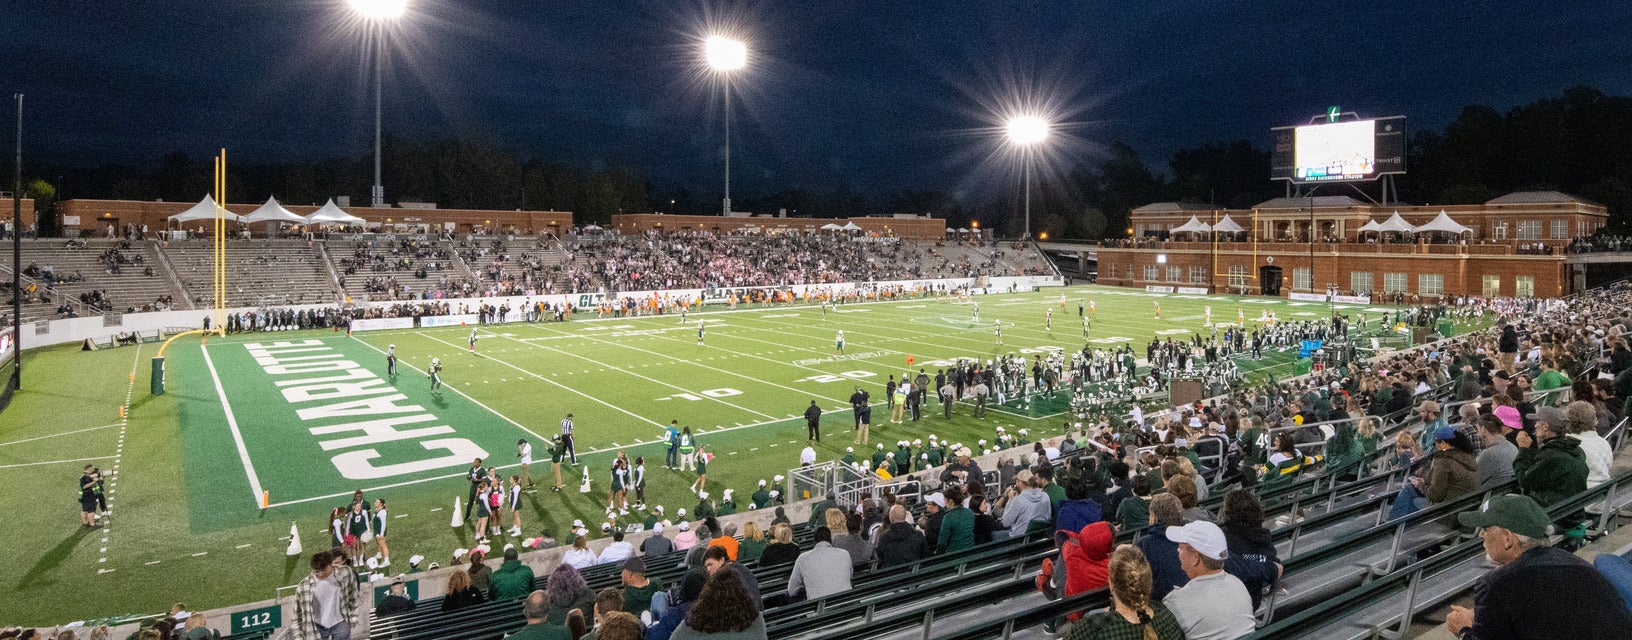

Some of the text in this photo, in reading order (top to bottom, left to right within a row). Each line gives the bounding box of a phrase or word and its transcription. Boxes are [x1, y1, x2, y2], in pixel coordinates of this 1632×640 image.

[669, 387, 744, 401] 10
[243, 339, 490, 480] CHARLOTTE
[241, 612, 271, 628] 112
